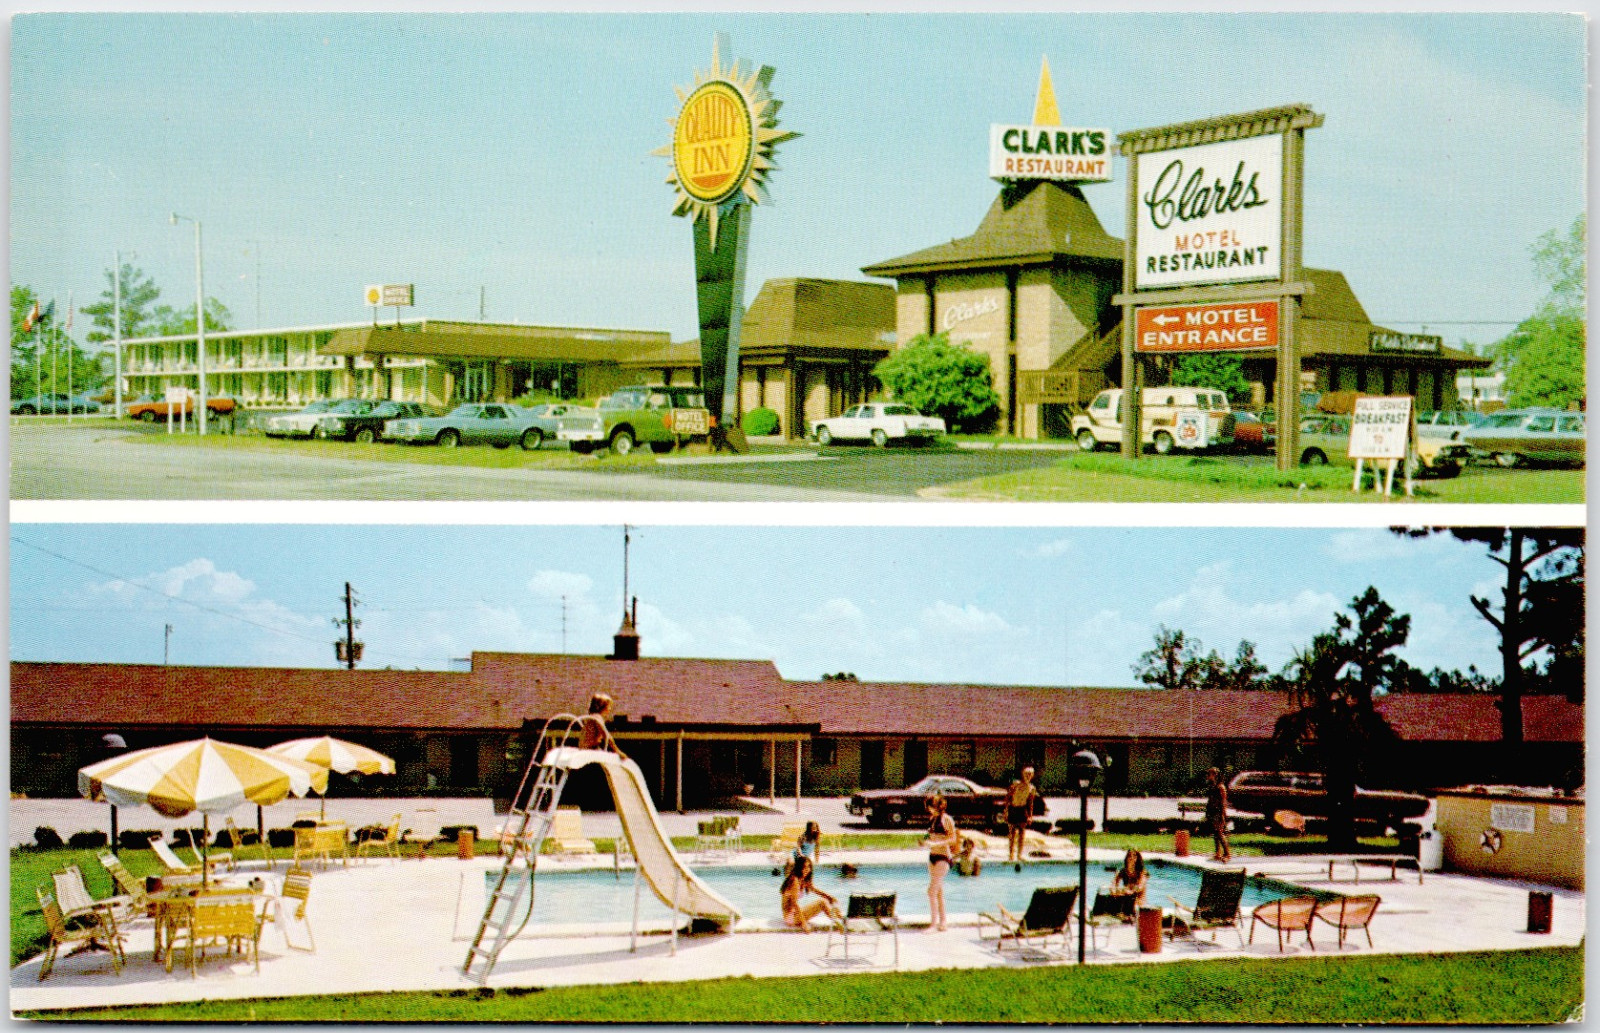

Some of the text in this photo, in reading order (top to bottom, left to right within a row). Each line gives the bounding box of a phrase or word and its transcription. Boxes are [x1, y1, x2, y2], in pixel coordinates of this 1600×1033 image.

[685, 94, 738, 143] QUALITY
[1002, 128, 1106, 156] CLARK'S
[693, 143, 731, 175] INN
[1005, 157, 1106, 174] RESTAURANT
[1143, 159, 1268, 229] Clarks
[1175, 229, 1242, 251] MOTEL
[1146, 246, 1268, 274] RESTAURANT
[1185, 308, 1265, 326] MOTEL
[1143, 326, 1268, 346] ENTRANCE
[676, 411, 704, 421] MOTEL
[1354, 412, 1407, 424] BREAKFAST
